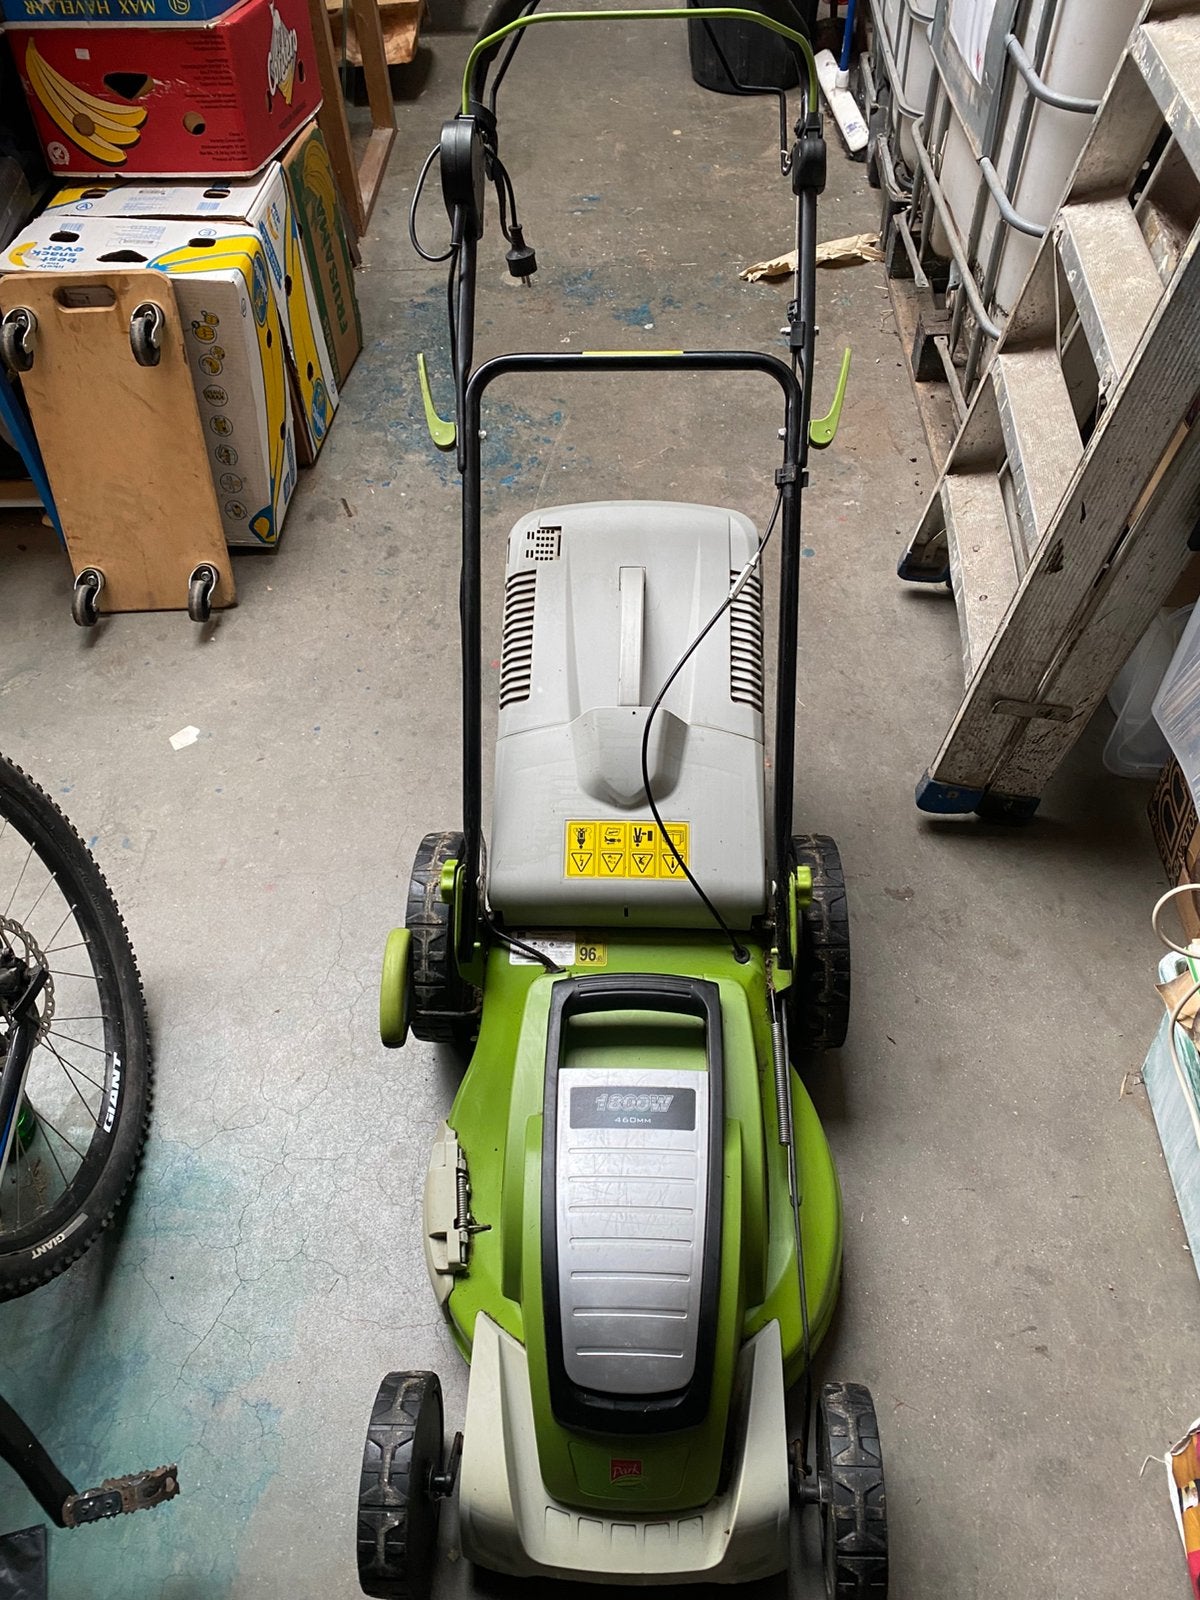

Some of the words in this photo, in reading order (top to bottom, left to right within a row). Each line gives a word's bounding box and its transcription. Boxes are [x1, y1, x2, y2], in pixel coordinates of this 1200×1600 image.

[26, 0, 111, 15] HAVELAAR
[120, 0, 156, 14] MAX
[579, 946, 598, 962] 96
[103, 1051, 121, 1134] GIANT
[595, 1093, 674, 1113] 1800W
[614, 1116, 652, 1124] 460MM
[31, 1233, 66, 1260] GIANT
